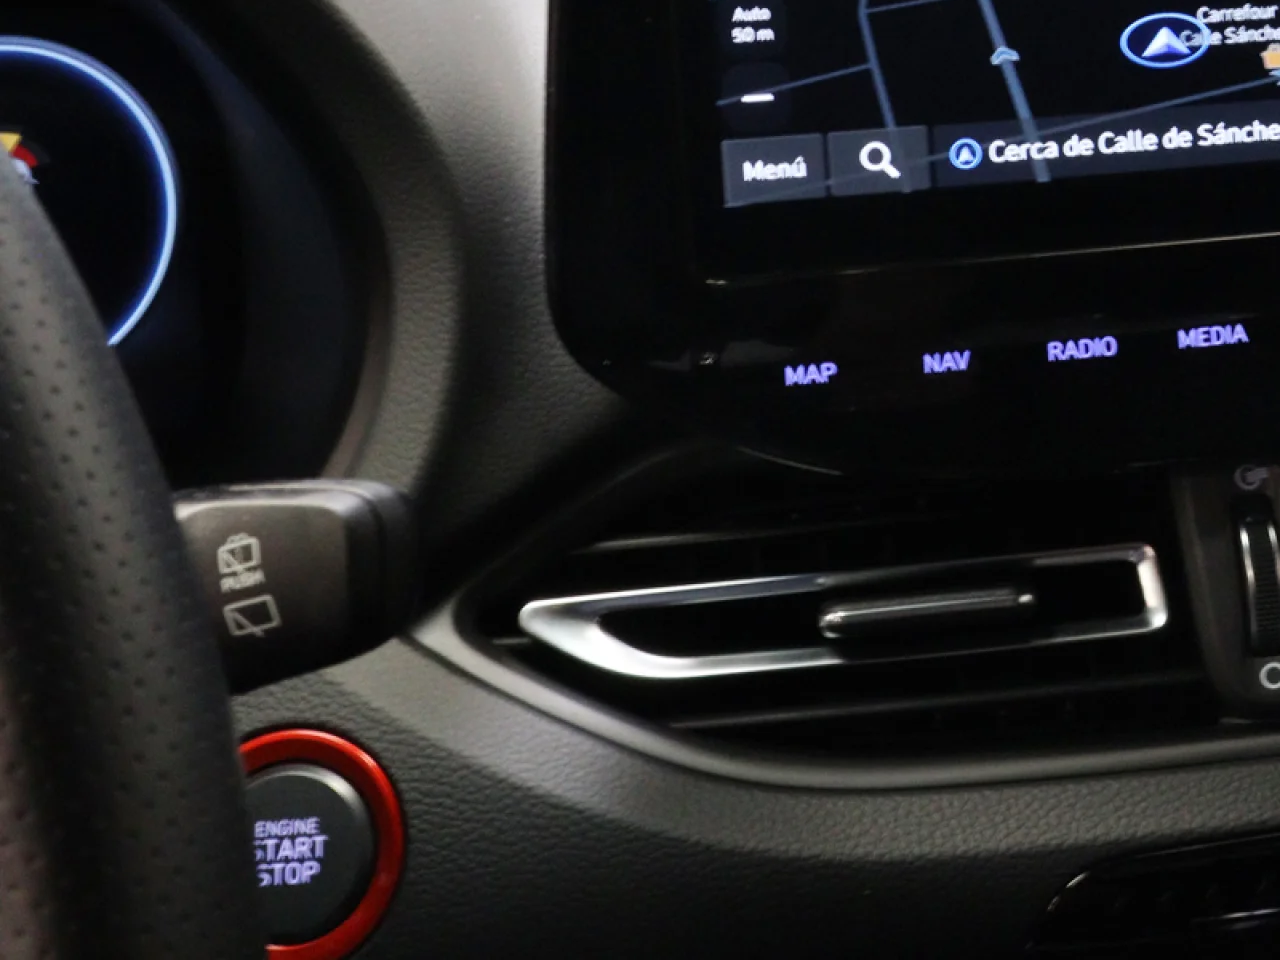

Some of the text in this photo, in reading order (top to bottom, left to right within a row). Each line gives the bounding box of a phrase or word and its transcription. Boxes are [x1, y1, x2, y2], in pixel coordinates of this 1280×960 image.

[732, 6, 771, 22] Auto
[1197, 2, 1278, 23] Carrefour
[988, 138, 1059, 163] Cerca
[1064, 134, 1093, 156] de
[1098, 129, 1157, 153] Calle
[1162, 126, 1192, 148] de
[743, 156, 807, 181] Menú
[1177, 324, 1248, 349] MEDIA
[1048, 336, 1117, 362] RADIO
[785, 362, 837, 386] MAP
[923, 350, 971, 374] NAV
[254, 817, 320, 837] ENGINE
